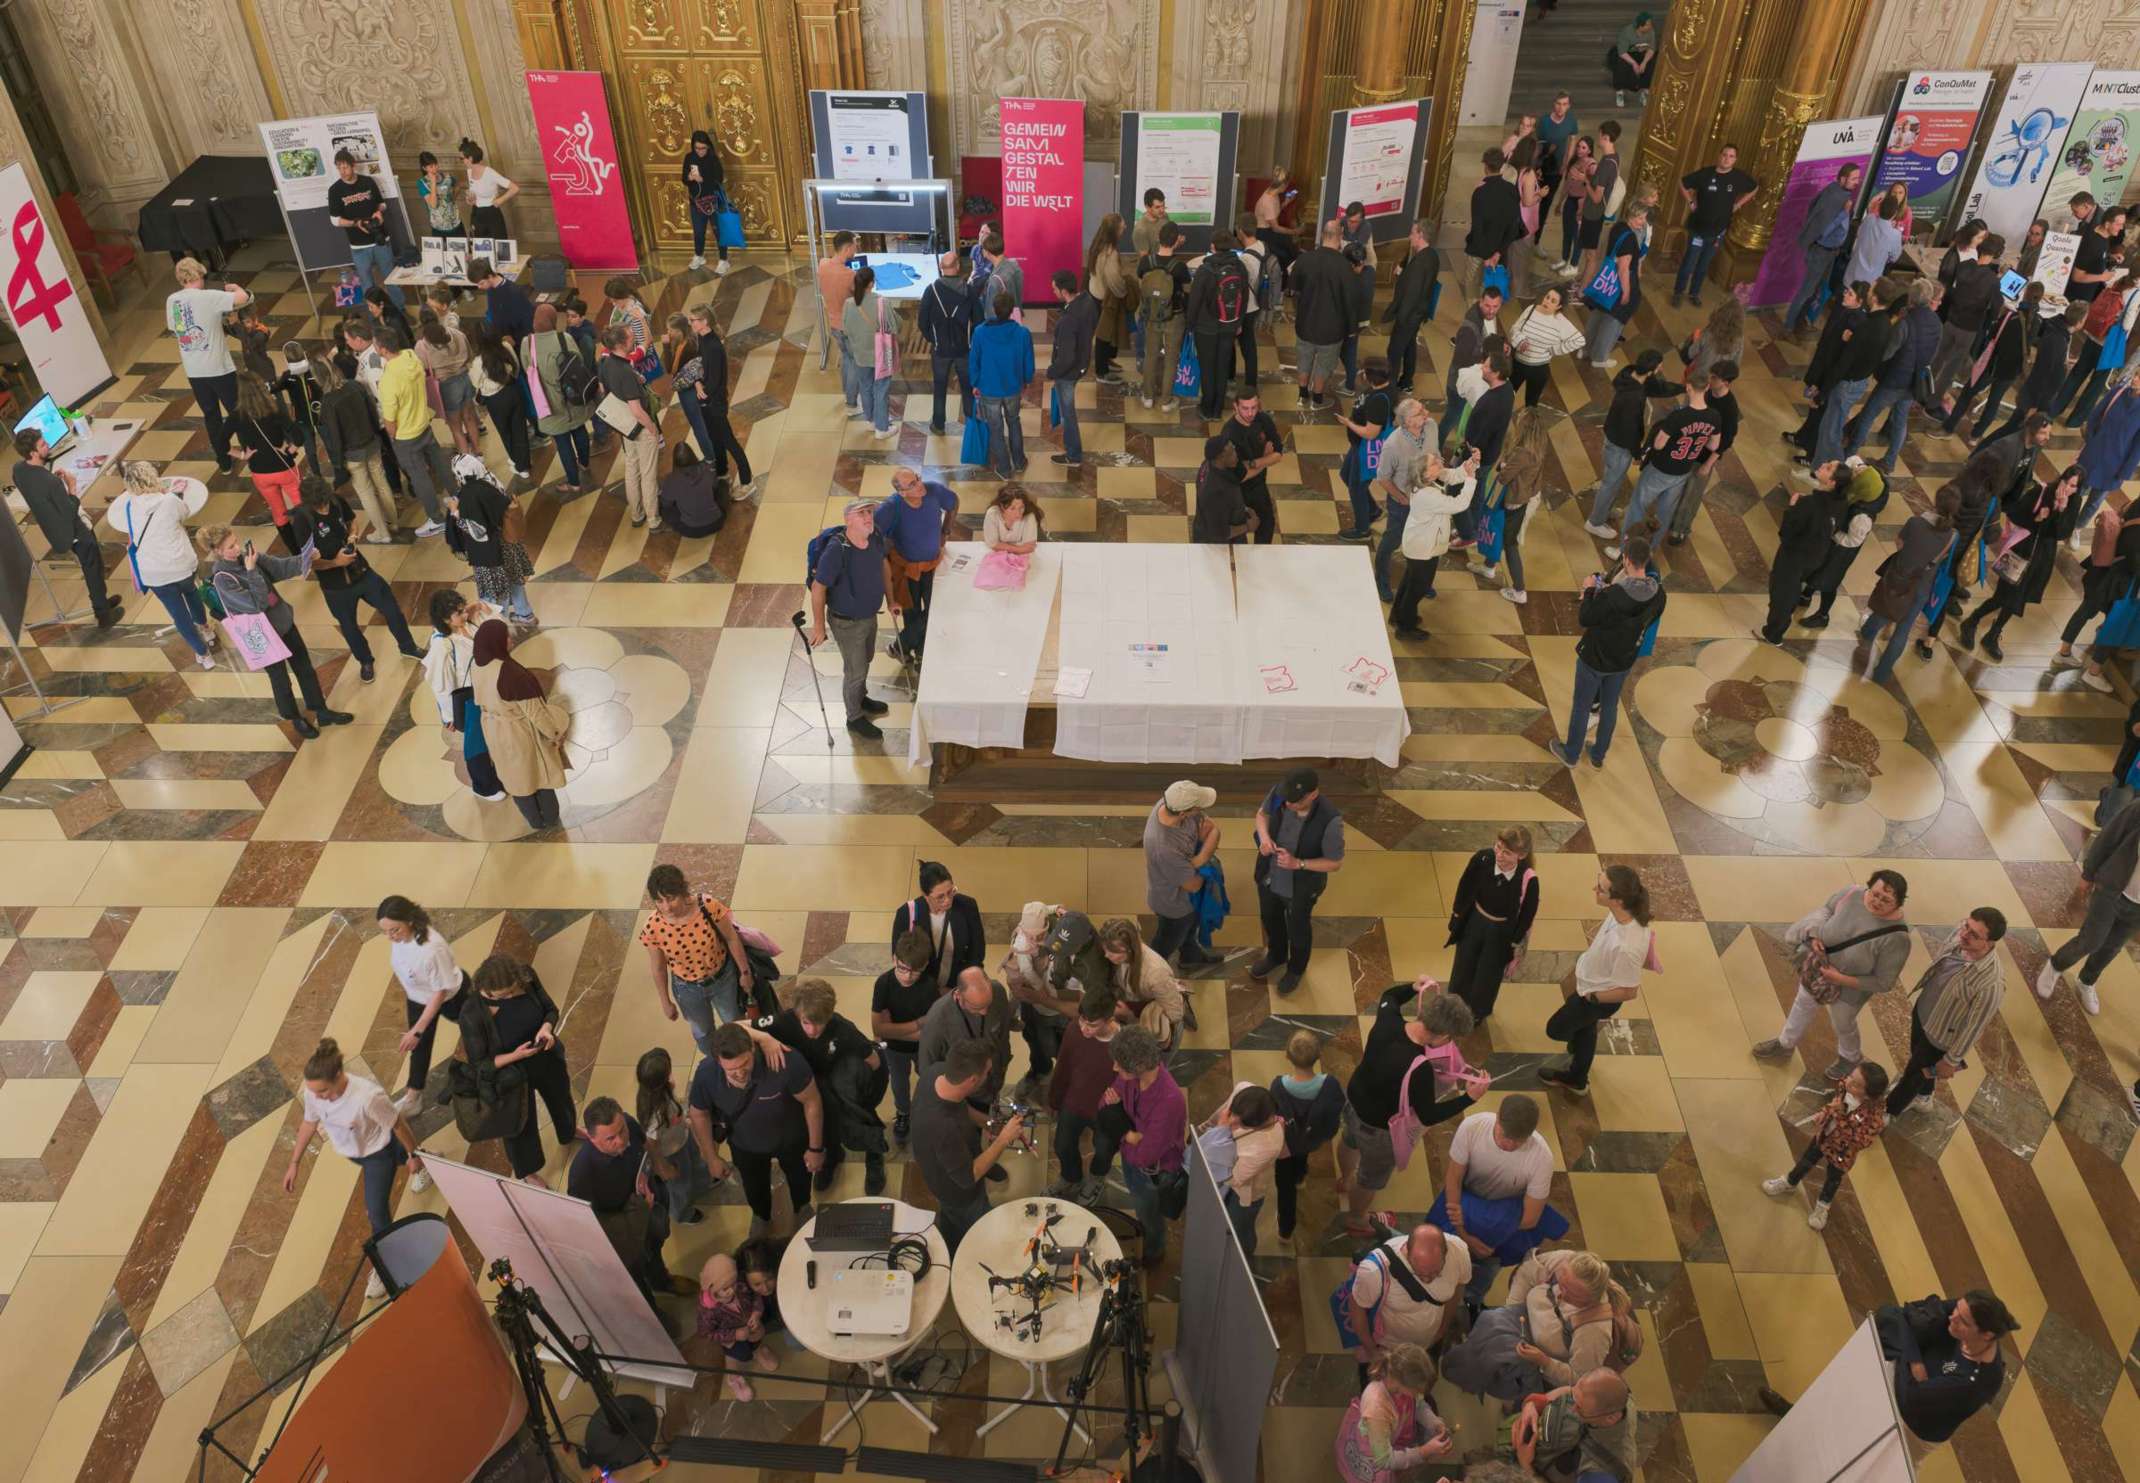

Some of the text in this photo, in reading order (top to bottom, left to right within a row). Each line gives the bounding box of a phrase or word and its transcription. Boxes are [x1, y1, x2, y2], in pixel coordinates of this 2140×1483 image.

[1934, 79, 1976, 89] ConQuMat
[1004, 122, 1067, 137] GEMEIN
[1004, 137, 1049, 151] SAM
[1004, 151, 1065, 166] GESTAL
[1005, 166, 1037, 179] TEN
[1006, 180, 1036, 193] WIR
[1006, 195, 1074, 212] DIE WELT
